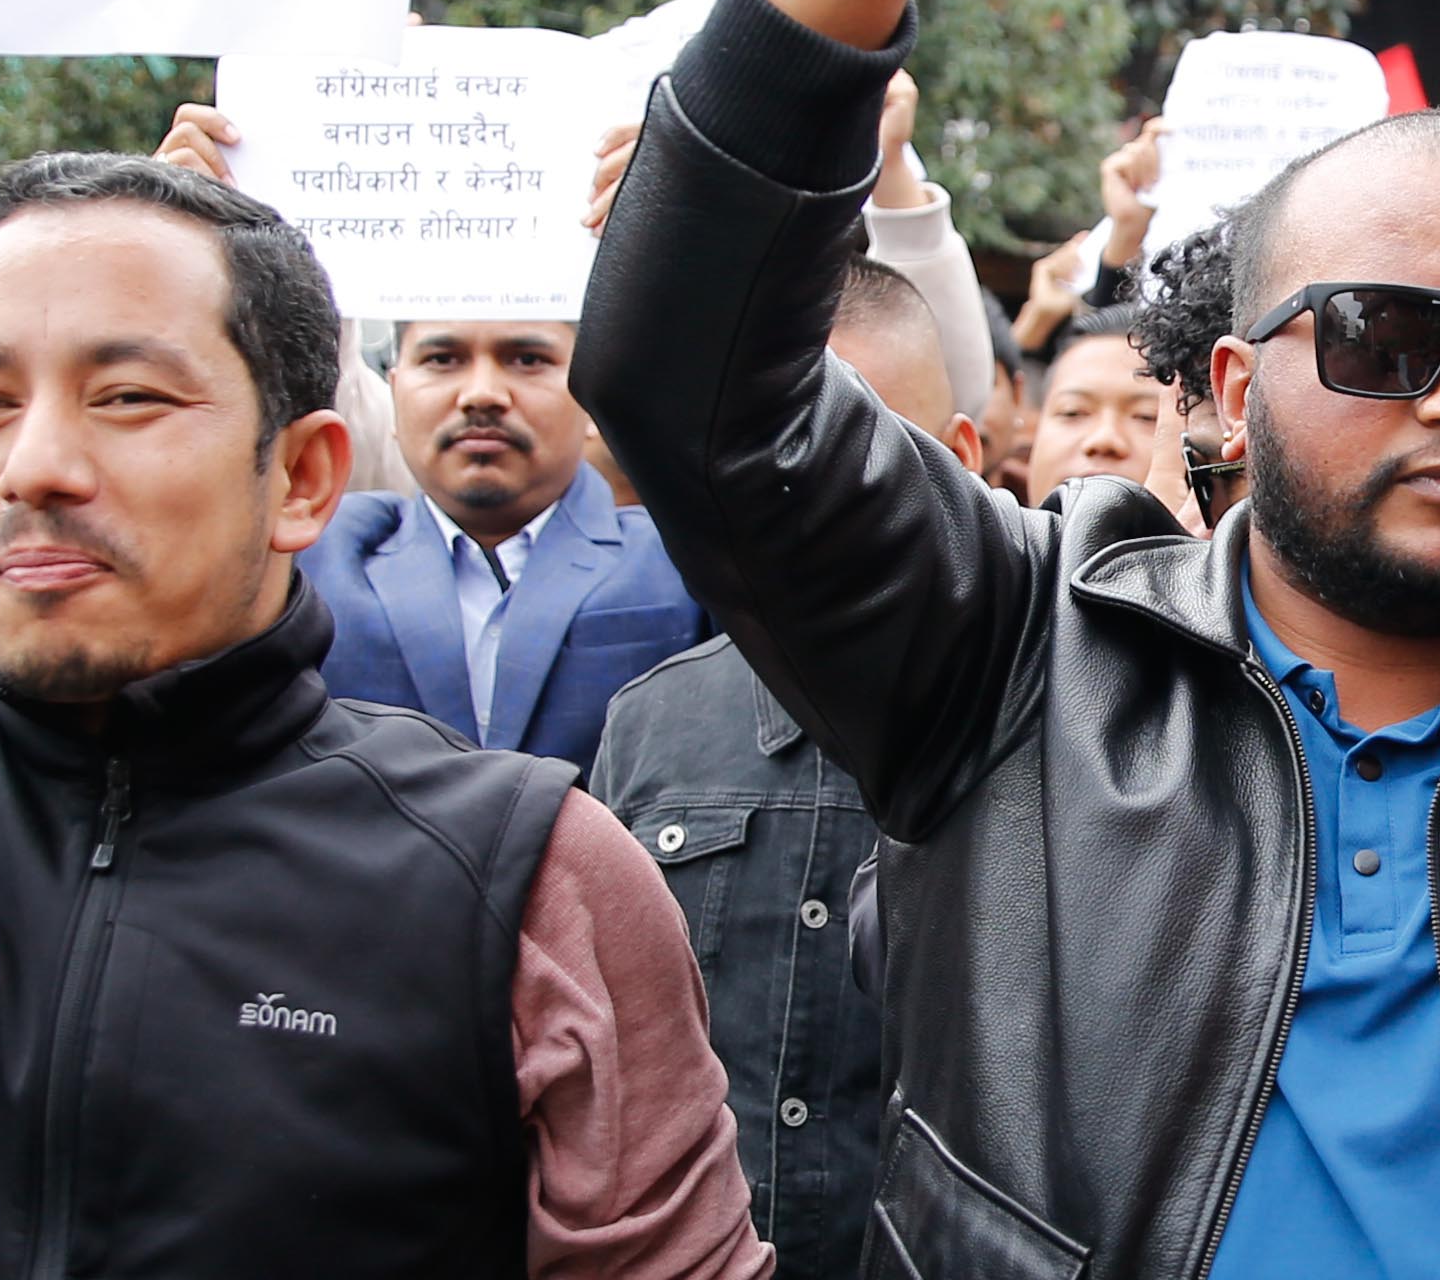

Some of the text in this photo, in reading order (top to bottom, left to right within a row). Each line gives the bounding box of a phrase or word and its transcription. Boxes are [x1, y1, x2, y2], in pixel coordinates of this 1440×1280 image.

[315, 68, 440, 101] काँग्रेसलाई
[322, 122, 415, 146] बनाउन
[290, 161, 546, 195] पदाधिकारी र केन्द्रीय
[419, 209, 518, 241] होसियार
